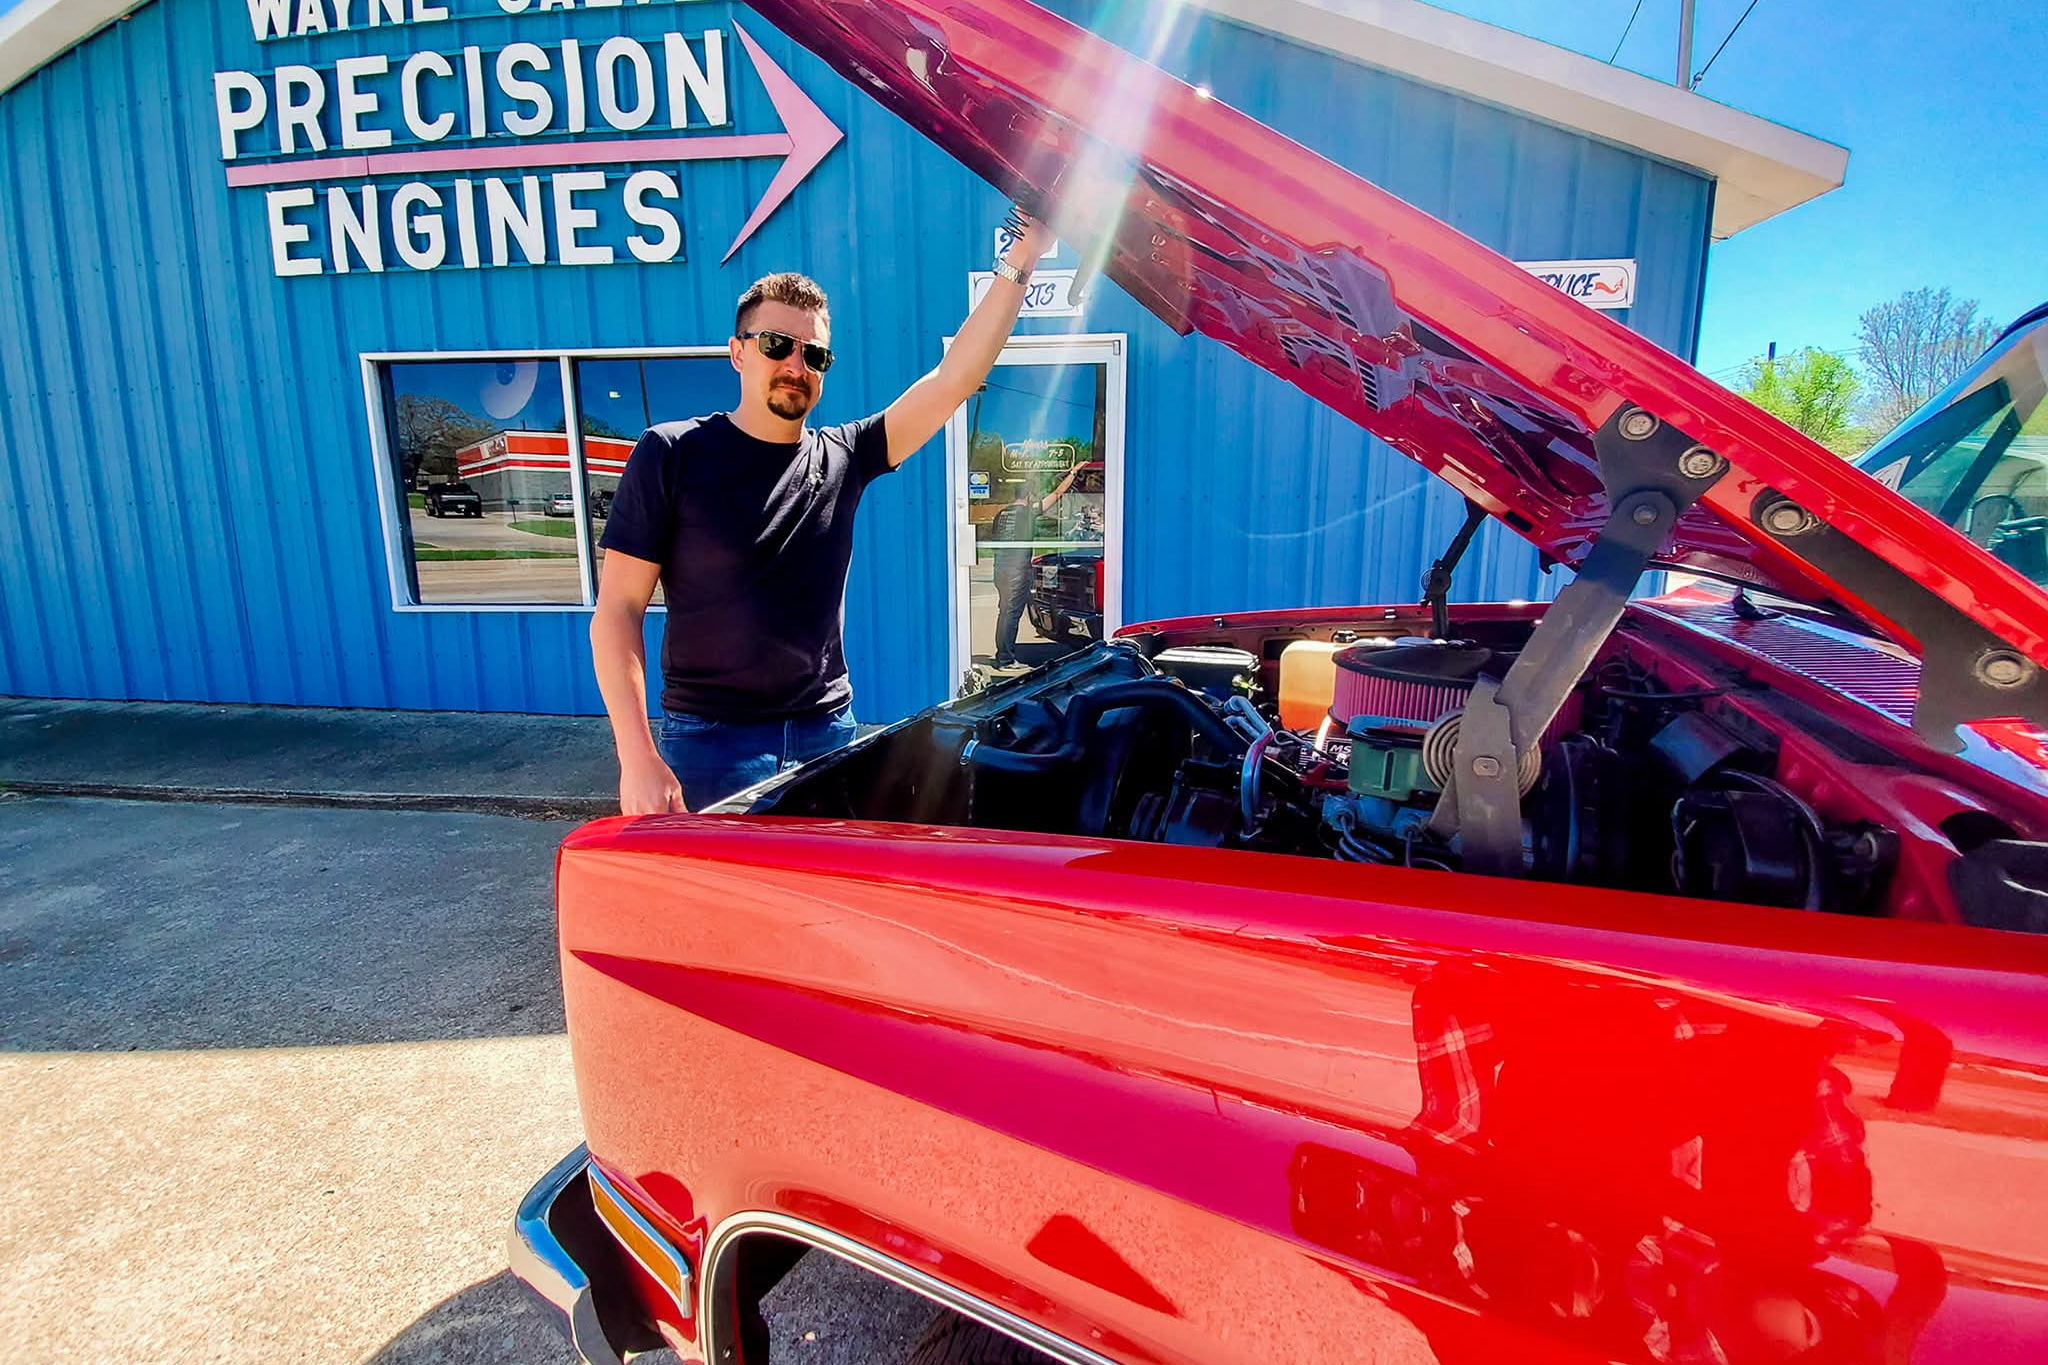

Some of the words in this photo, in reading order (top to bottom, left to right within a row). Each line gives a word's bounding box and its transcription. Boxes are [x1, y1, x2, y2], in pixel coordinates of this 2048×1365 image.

[213, 28, 728, 160] PRECISION
[266, 169, 681, 277] ENGINES
[1024, 282, 1057, 308] RTS
[1538, 272, 1601, 297] RVICE
